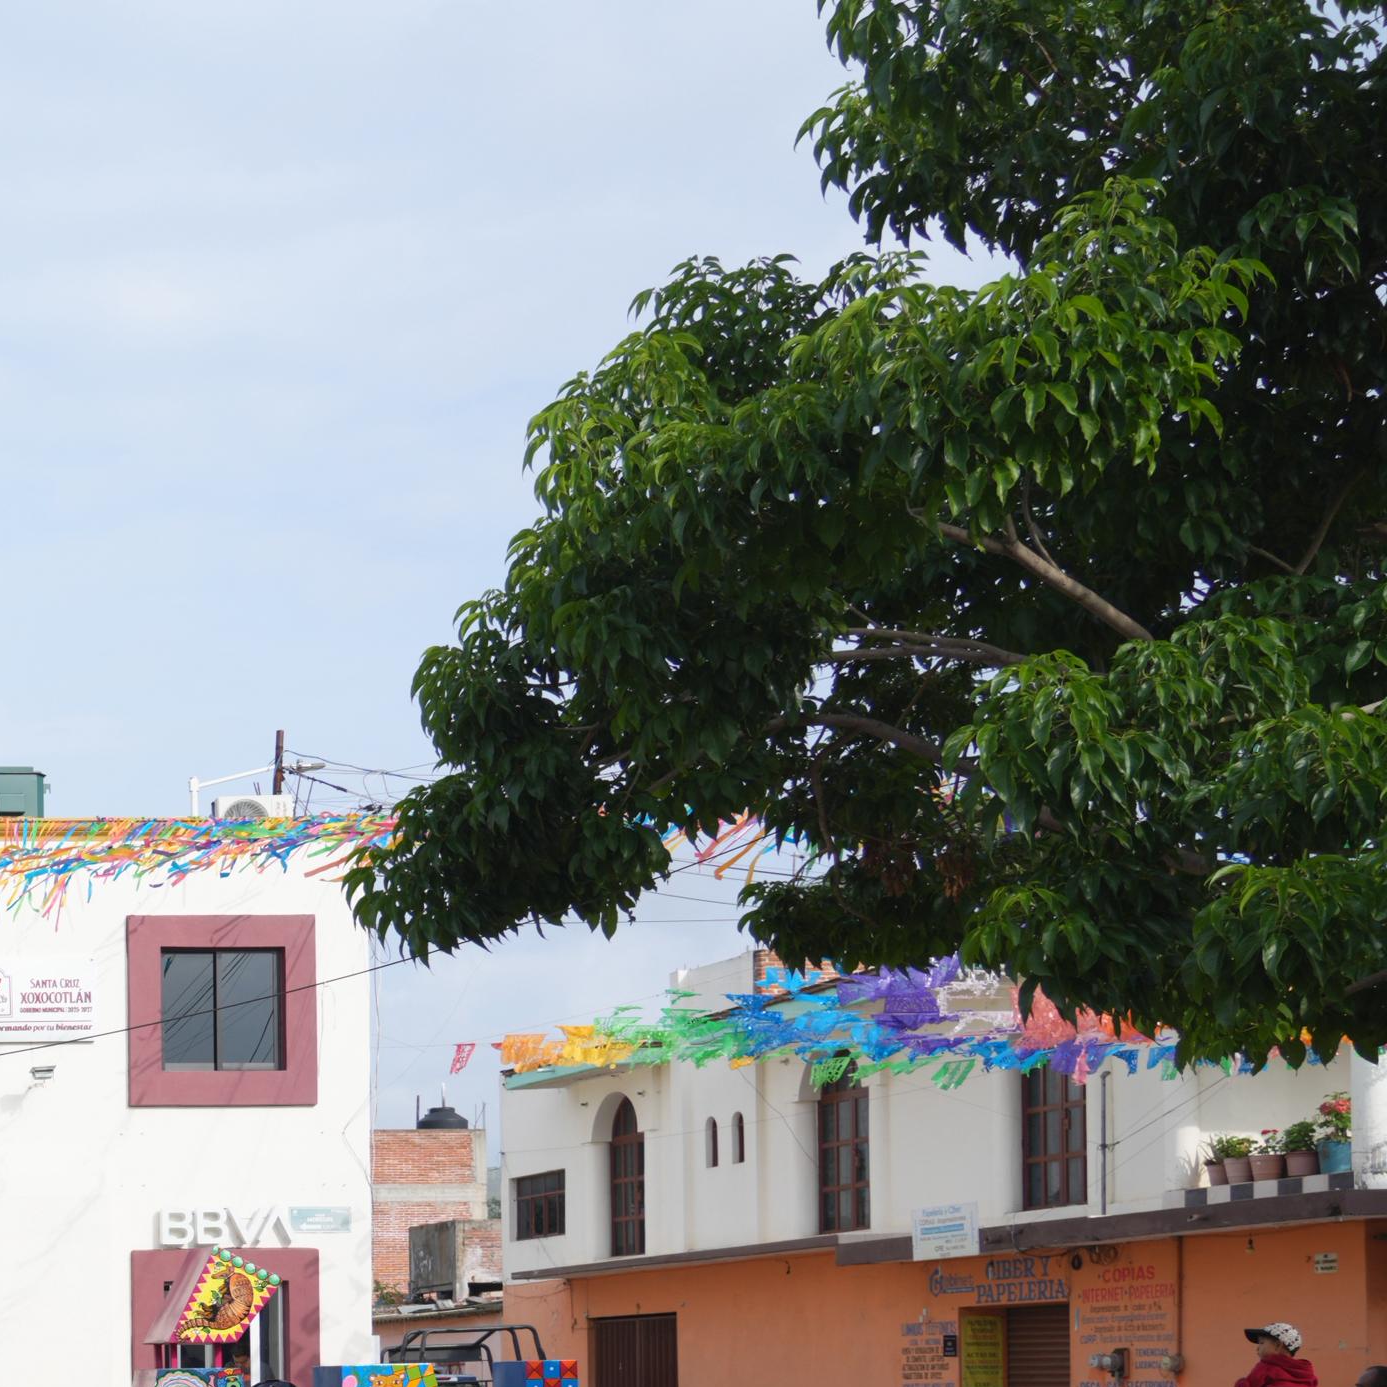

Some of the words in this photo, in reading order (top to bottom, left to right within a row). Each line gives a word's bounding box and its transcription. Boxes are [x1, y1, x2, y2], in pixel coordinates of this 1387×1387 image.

[29, 978, 58, 989] SANTA
[60, 978, 80, 988] CRUZ
[20, 988, 92, 1004] XOXOCOTLÁN
[56, 1023, 93, 1031] bienestar
[159, 1206, 290, 1247] BBVA
[1102, 1265, 1155, 1283] COPIAS
[975, 1279, 1068, 1304] PAPELERIA
[1082, 1287, 1124, 1304] INTERNET
[1129, 1284, 1176, 1300] PAPELERIA
